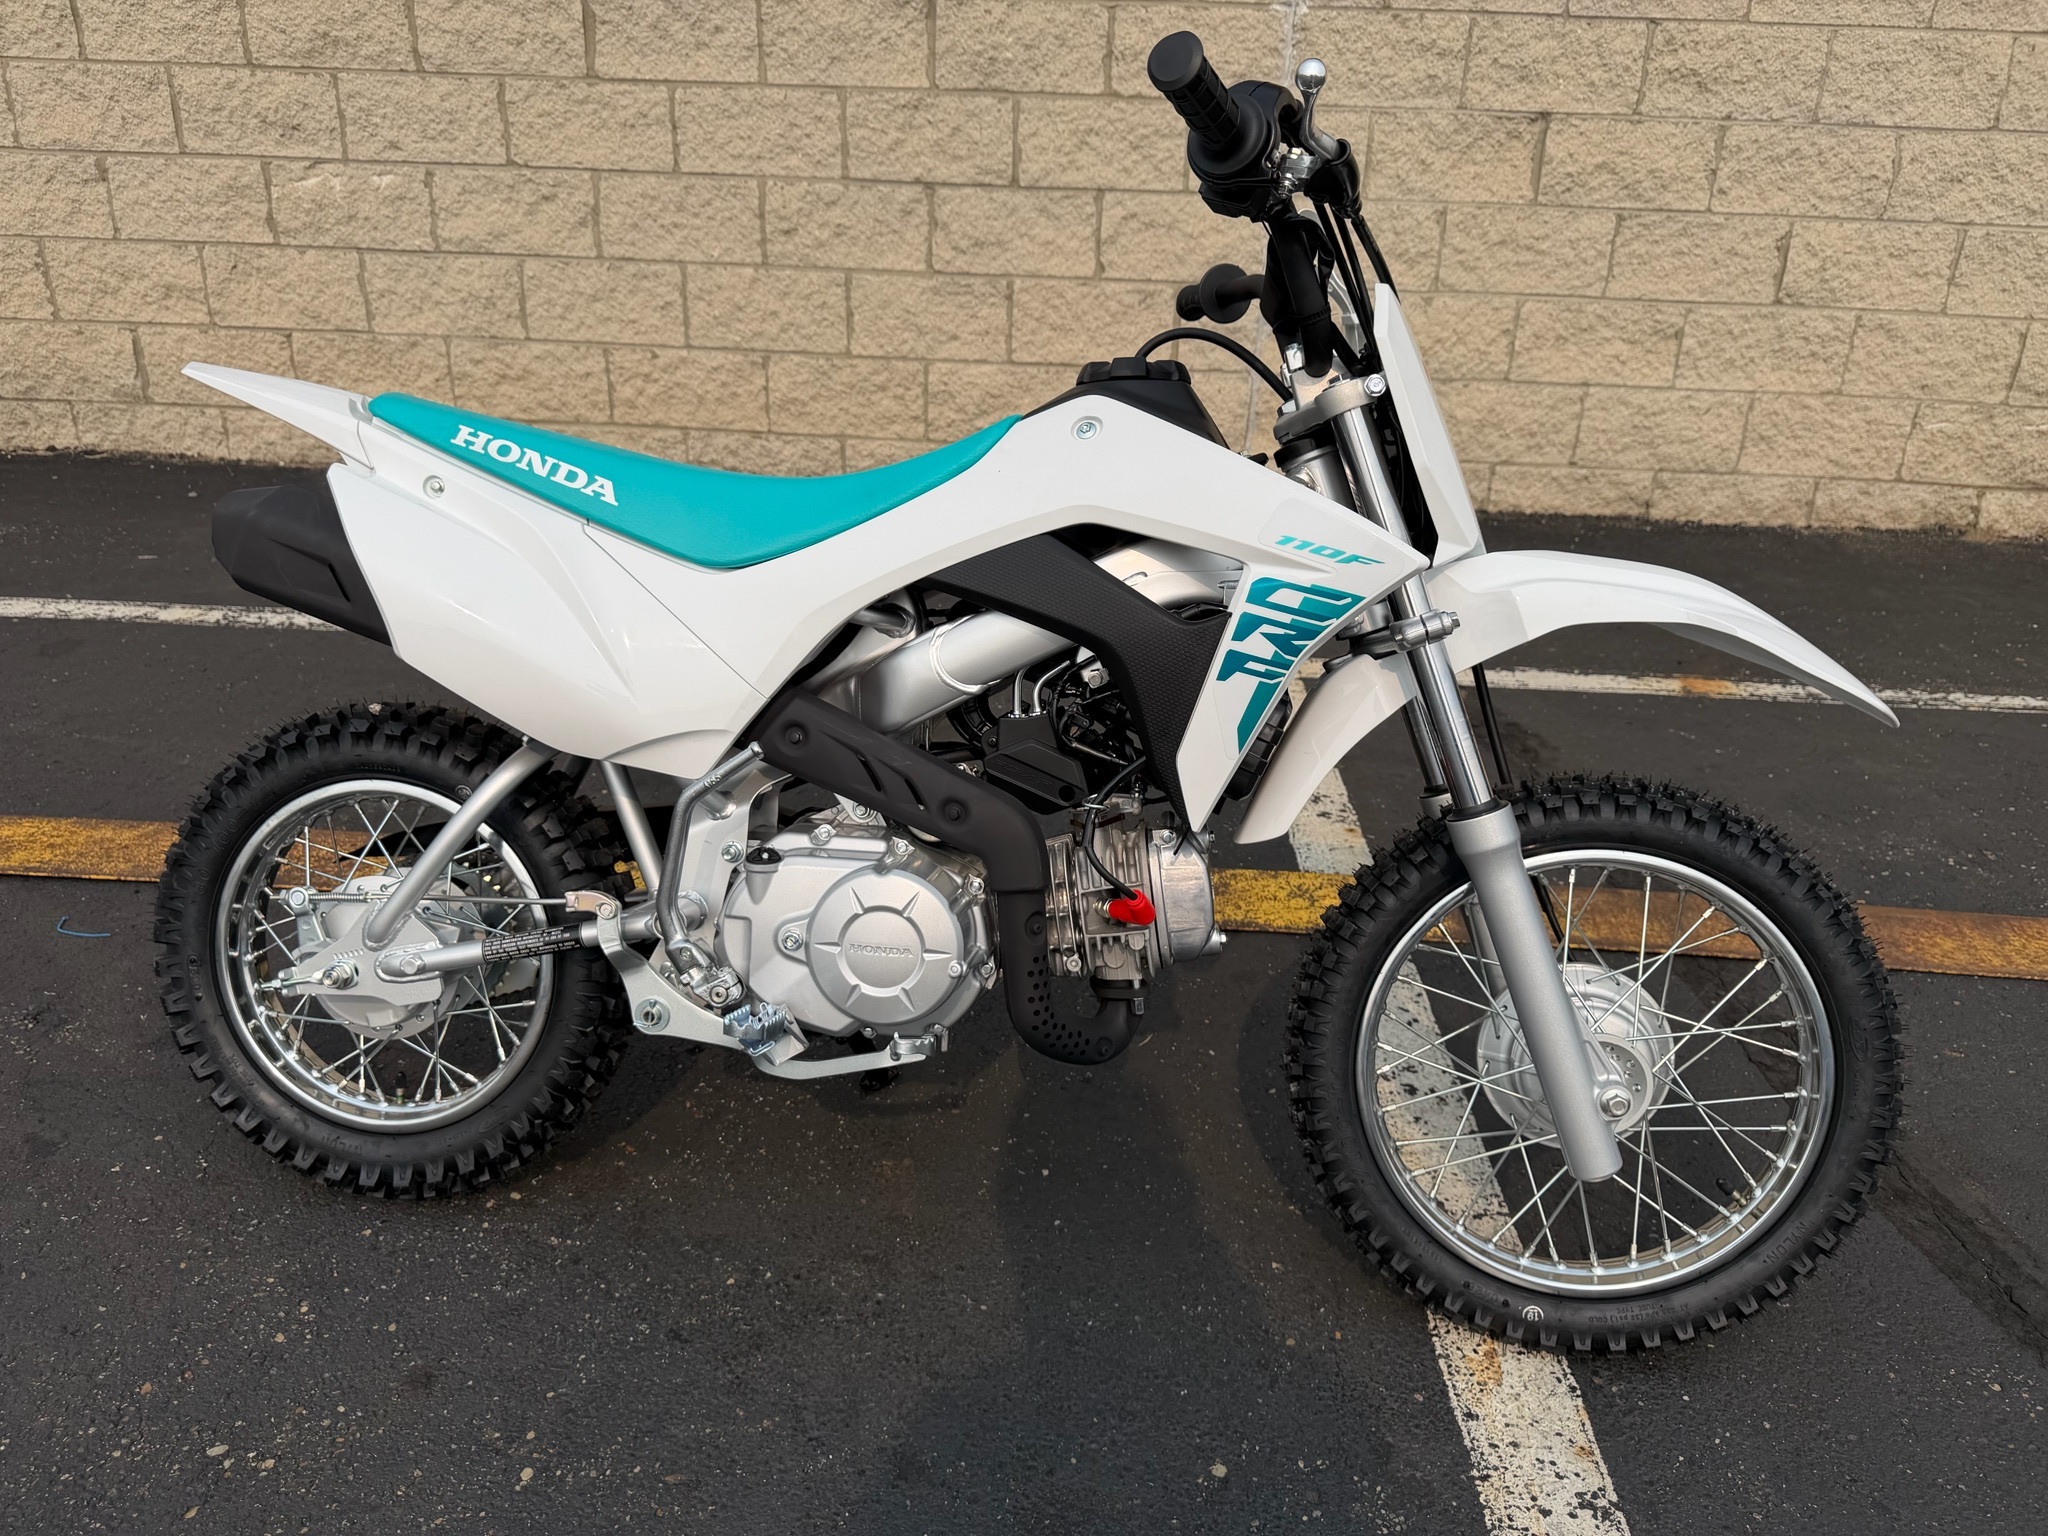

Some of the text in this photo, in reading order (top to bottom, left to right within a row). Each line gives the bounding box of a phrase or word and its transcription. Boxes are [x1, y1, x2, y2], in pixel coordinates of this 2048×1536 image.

[450, 424, 618, 506] HONDA
[1275, 535, 1386, 565] 110F
[849, 943, 915, 958] HONDA
[1766, 1221, 1808, 1263] NYLON
[1527, 1309, 1539, 1321] 19
